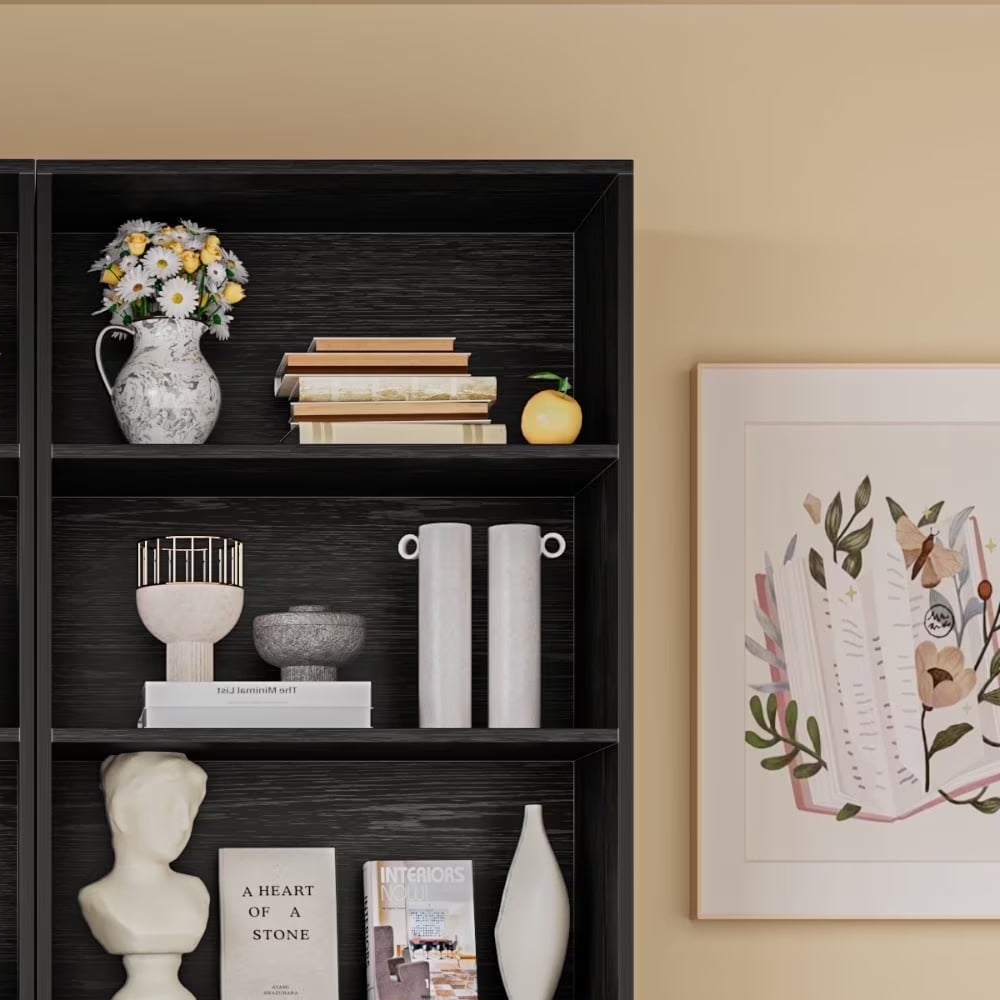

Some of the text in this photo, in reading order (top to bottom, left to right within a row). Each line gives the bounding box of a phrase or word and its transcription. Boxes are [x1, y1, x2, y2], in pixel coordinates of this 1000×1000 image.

[380, 866, 465, 884] INTERIORS
[242, 885, 315, 897] A HEART
[248, 906, 301, 918] OF A
[252, 929, 311, 941] STONE
